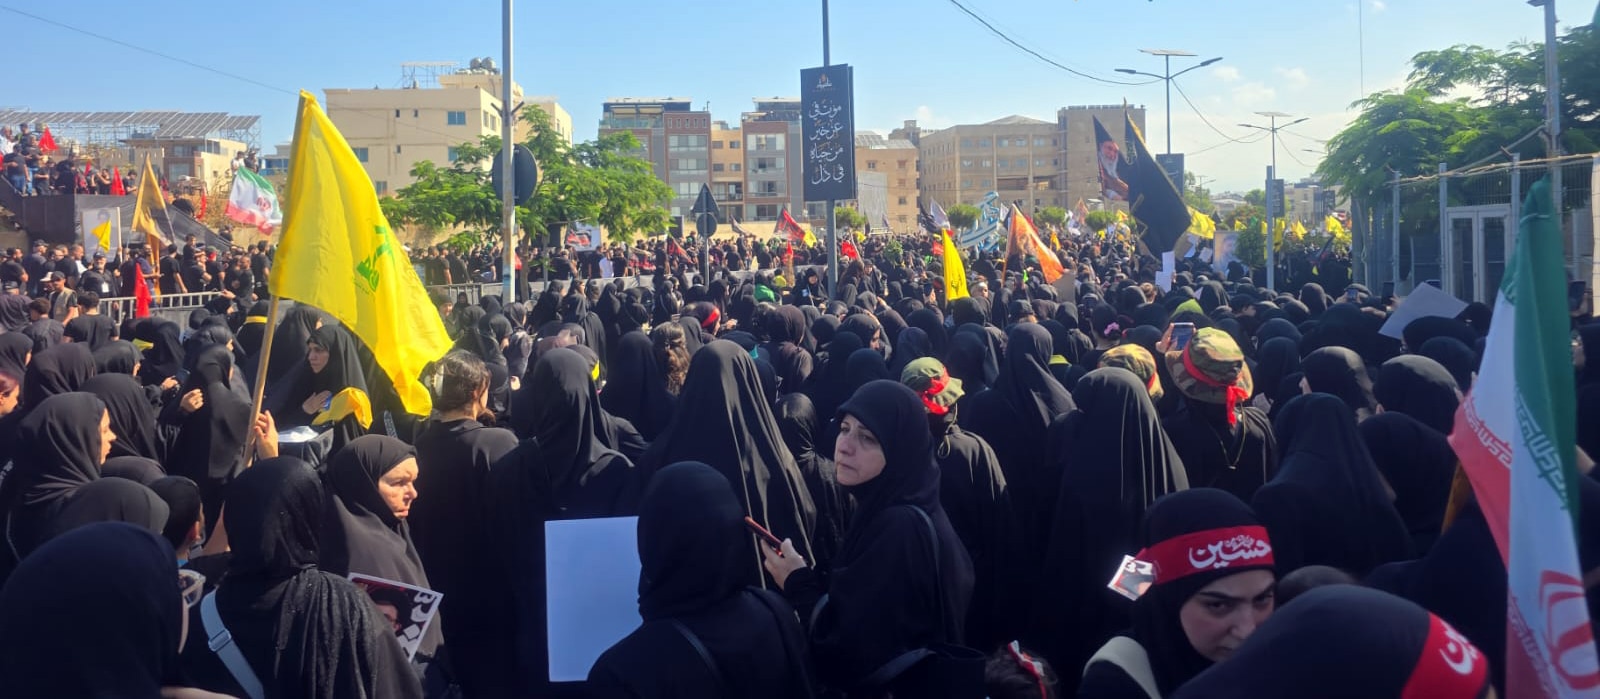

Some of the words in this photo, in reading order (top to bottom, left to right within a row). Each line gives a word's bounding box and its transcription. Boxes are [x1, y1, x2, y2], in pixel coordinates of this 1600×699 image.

[825, 147, 843, 162] من
[832, 163, 845, 183] في
[1188, 538, 1272, 569] حسين
